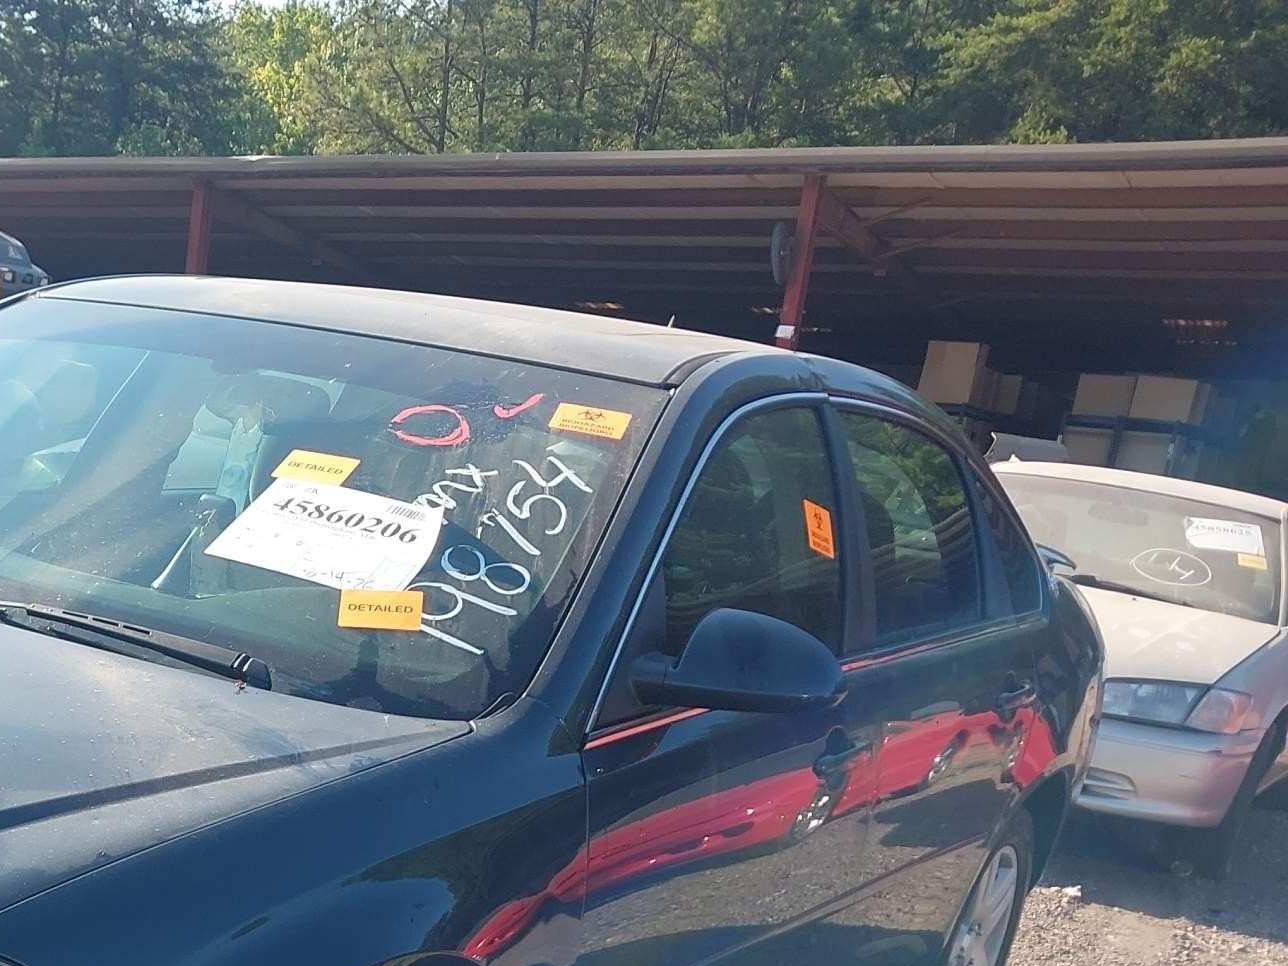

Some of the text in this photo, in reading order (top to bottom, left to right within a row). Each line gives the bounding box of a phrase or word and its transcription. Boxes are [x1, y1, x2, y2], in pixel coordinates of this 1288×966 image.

[287, 460, 344, 475] DETAILED
[271, 497, 422, 544] 45860206
[347, 602, 415, 615] DETAILED
